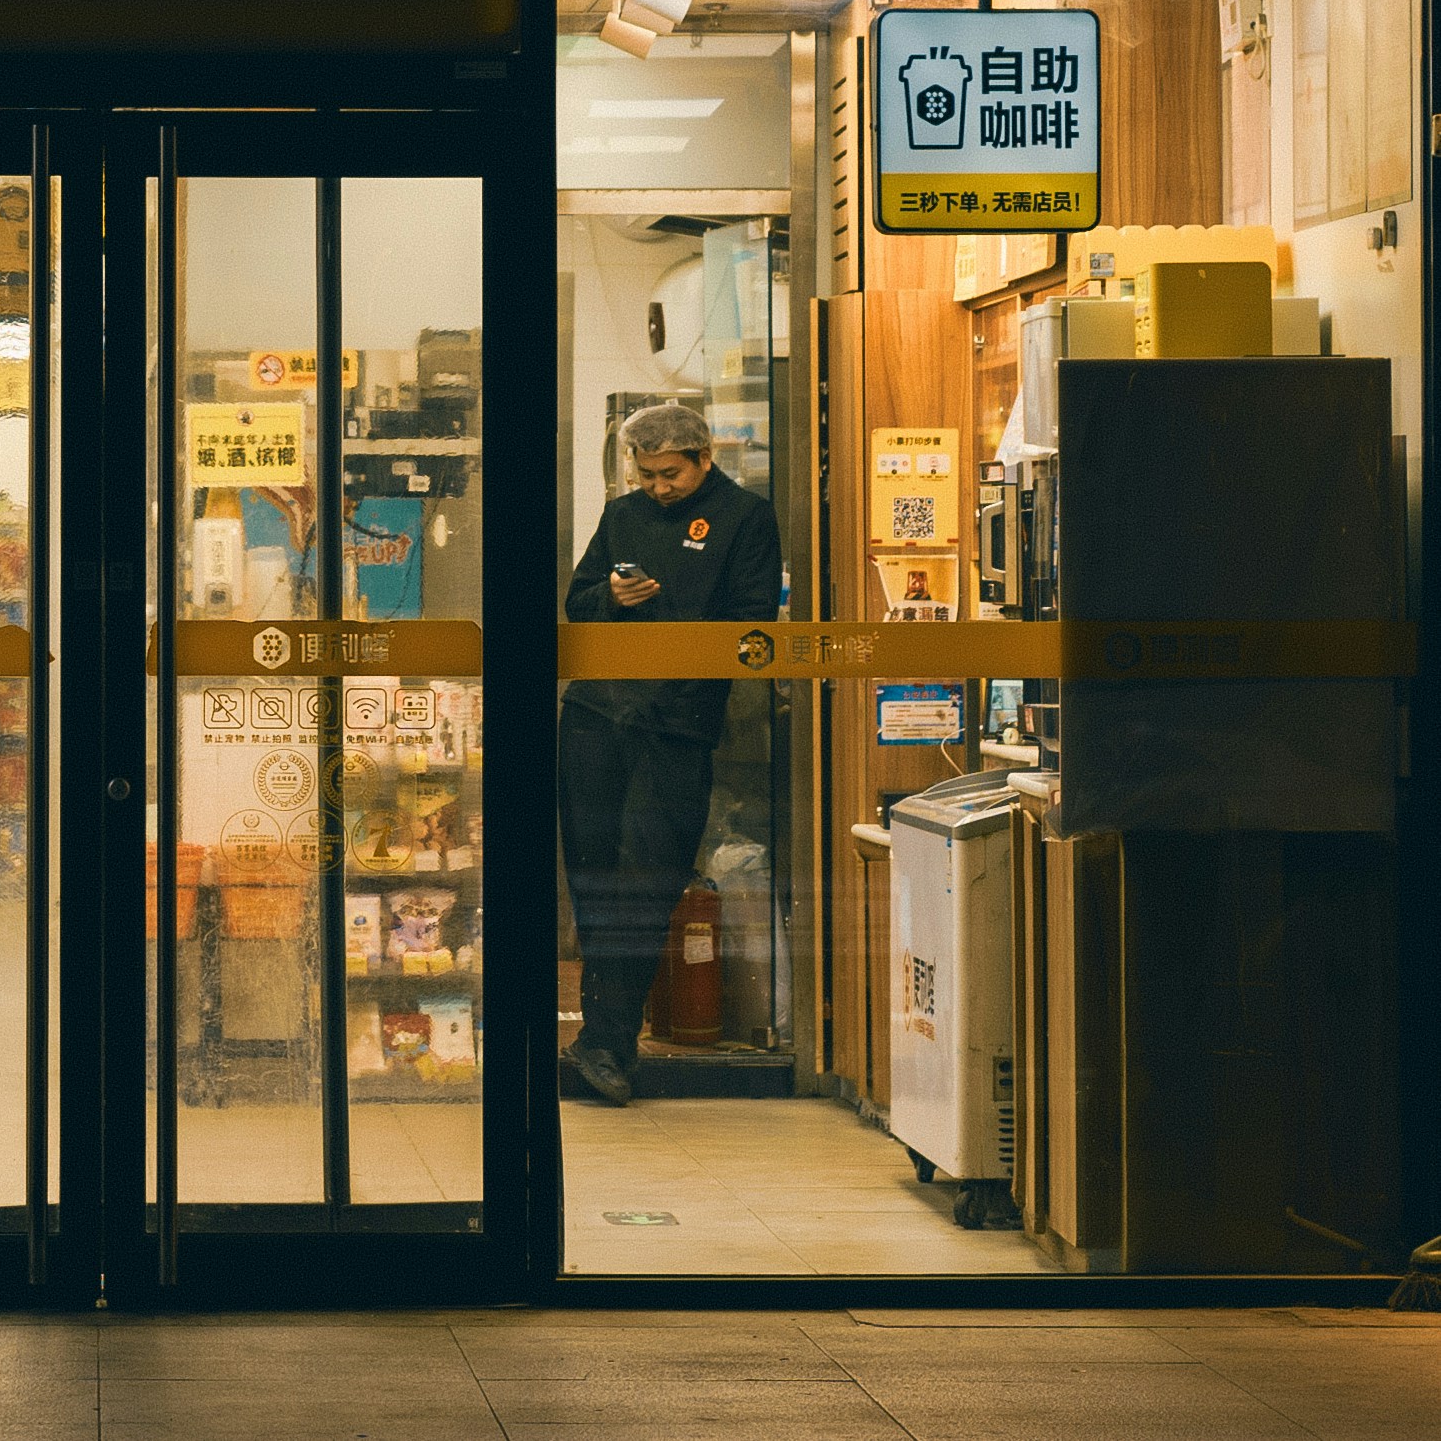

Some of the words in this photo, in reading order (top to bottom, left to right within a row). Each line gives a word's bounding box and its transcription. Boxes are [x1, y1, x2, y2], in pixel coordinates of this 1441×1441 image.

[981, 45, 1079, 95] 自助
[980, 101, 1079, 149] 咖啡
[899, 192, 1080, 213] 三秒下单,无需店员!
[299, 632, 390, 664] 便利蜂
